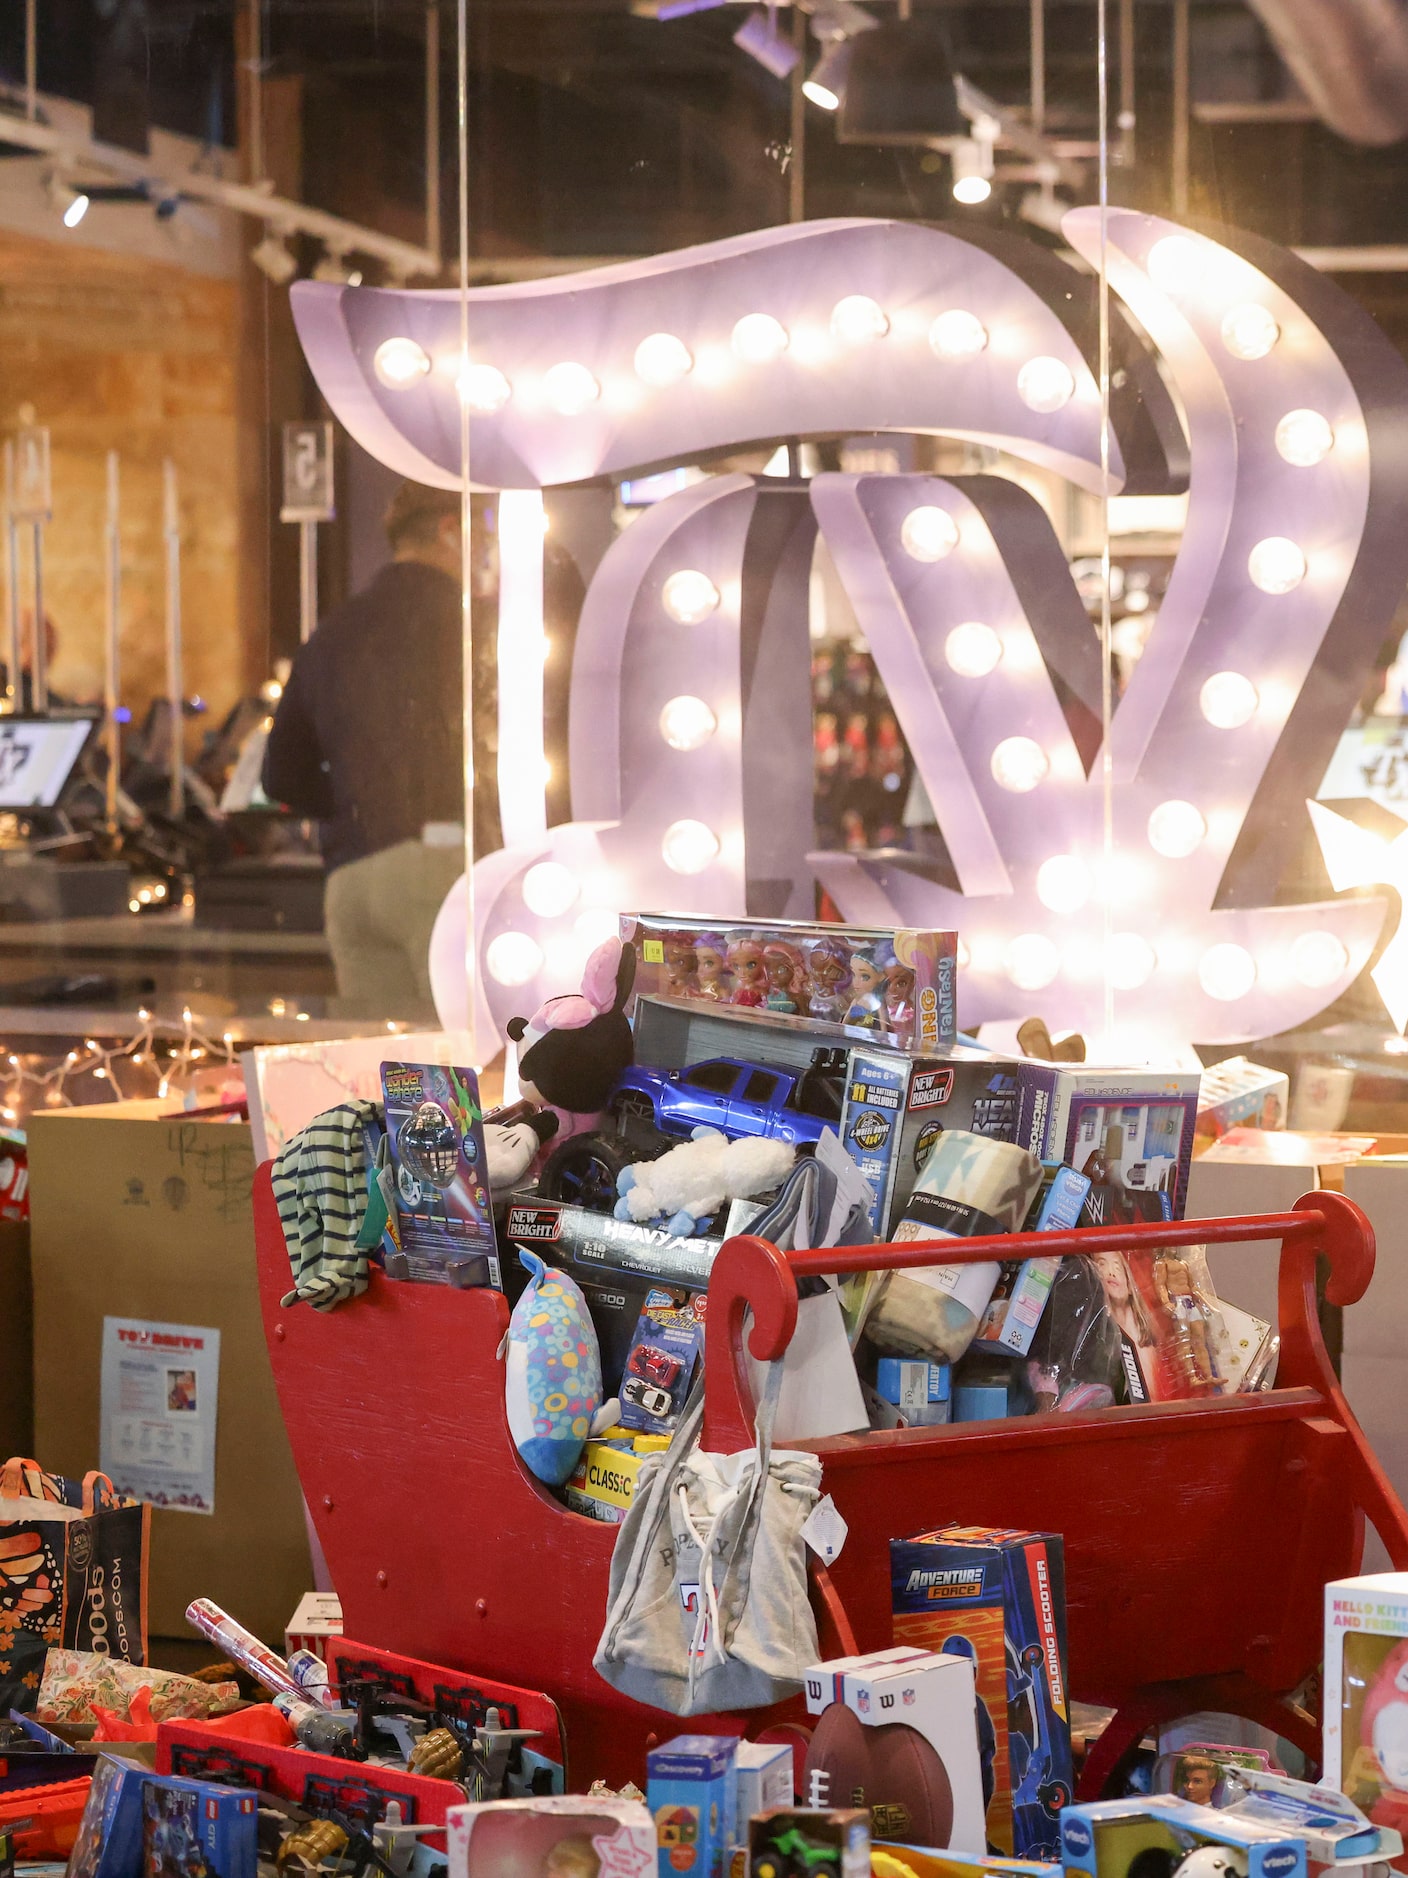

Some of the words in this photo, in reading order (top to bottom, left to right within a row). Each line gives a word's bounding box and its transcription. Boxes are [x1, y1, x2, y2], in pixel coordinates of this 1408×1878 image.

[914, 1075, 935, 1091] NEW
[867, 1094, 898, 1109] INCLUDED
[911, 1087, 945, 1106] BRIGHT
[512, 1210, 538, 1224] NEW
[510, 1223, 553, 1238] BRIGHT
[603, 1220, 669, 1247] HEAVY
[582, 1249, 606, 1260] SCALE
[583, 1240, 606, 1254] 1:10
[621, 1260, 662, 1274] CHEVROLET
[1121, 1343, 1145, 1400] RIDDLE
[905, 1567, 984, 1592] ADVENTURE
[1036, 1560, 1055, 1634] SCOOTER
[1333, 1600, 1373, 1615] HELLO
[1333, 1615, 1361, 1628] AND
[1046, 1637, 1062, 1705] FOLDING
